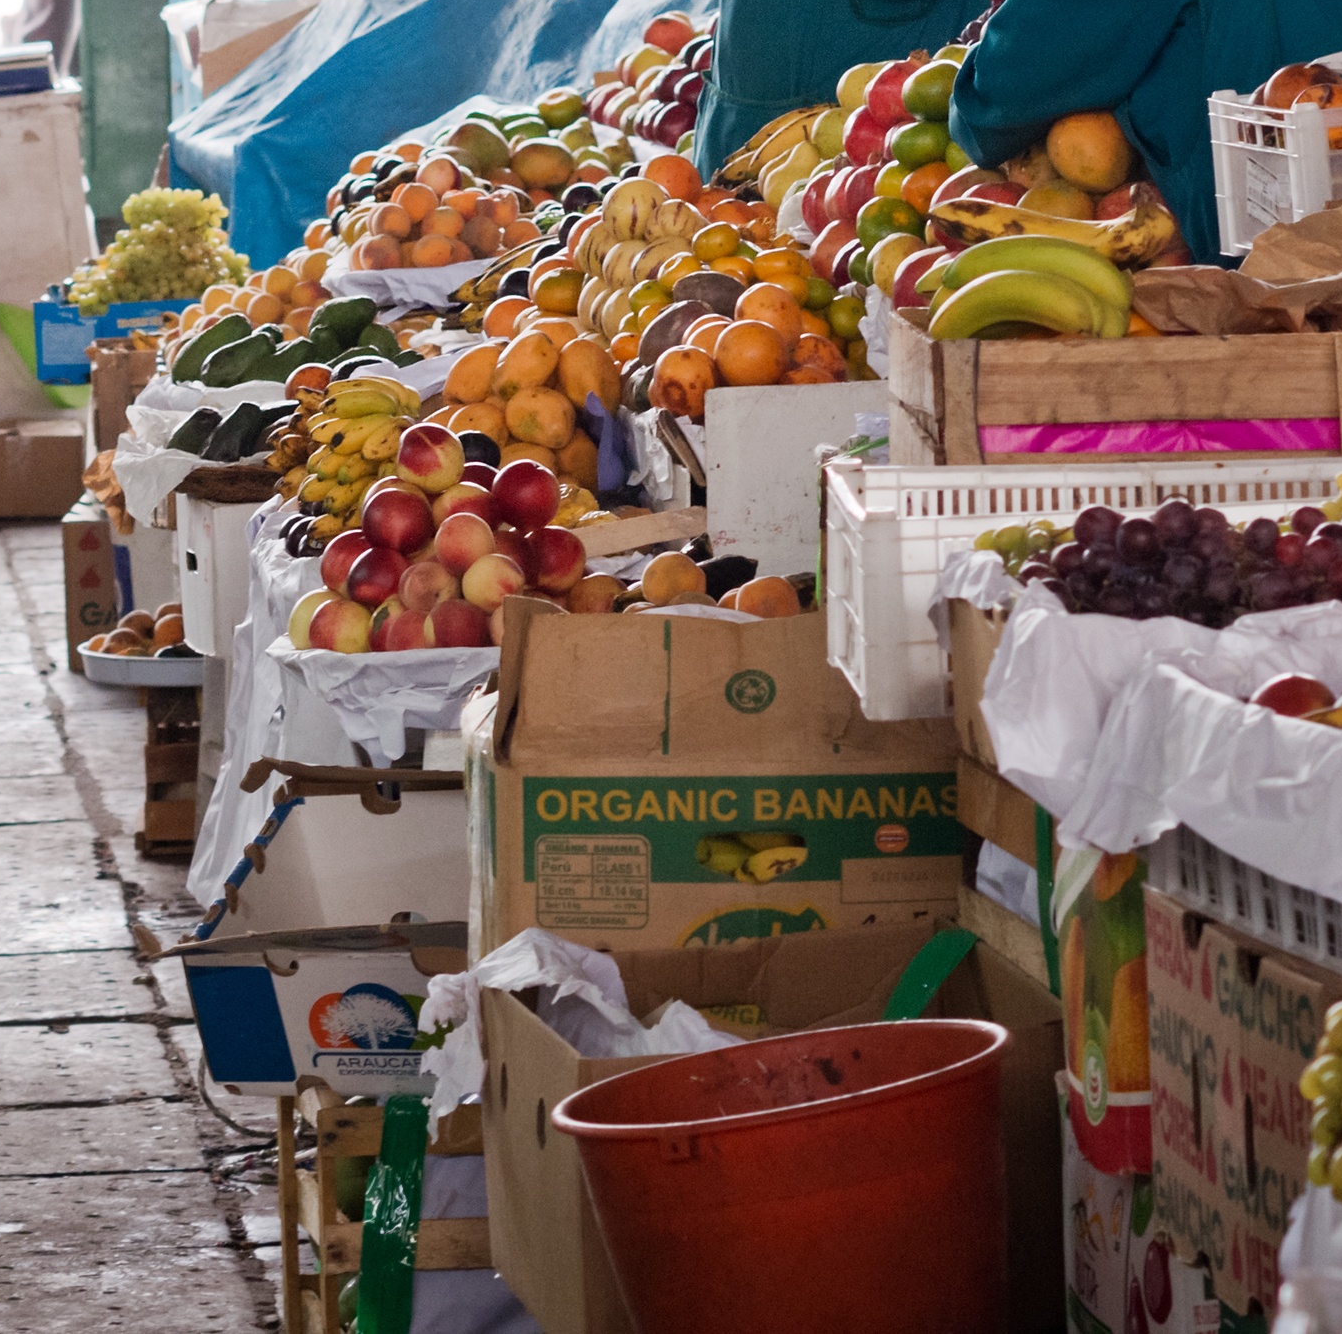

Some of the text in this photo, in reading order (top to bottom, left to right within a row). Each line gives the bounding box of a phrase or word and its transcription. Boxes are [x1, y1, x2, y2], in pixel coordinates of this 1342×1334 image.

[536, 783, 957, 822] ORGANIC BANANAS
[541, 861, 571, 873] Perú
[557, 887, 576, 896] cm
[596, 863, 633, 874] CLASS
[629, 885, 643, 899] kg
[1215, 951, 1317, 1060] GAUCHO
[1148, 991, 1217, 1094] GAUCHO
[1239, 1056, 1312, 1150] PEAR
[1153, 1159, 1225, 1272] GAUCHO
[1221, 1138, 1300, 1234] GAUCH
